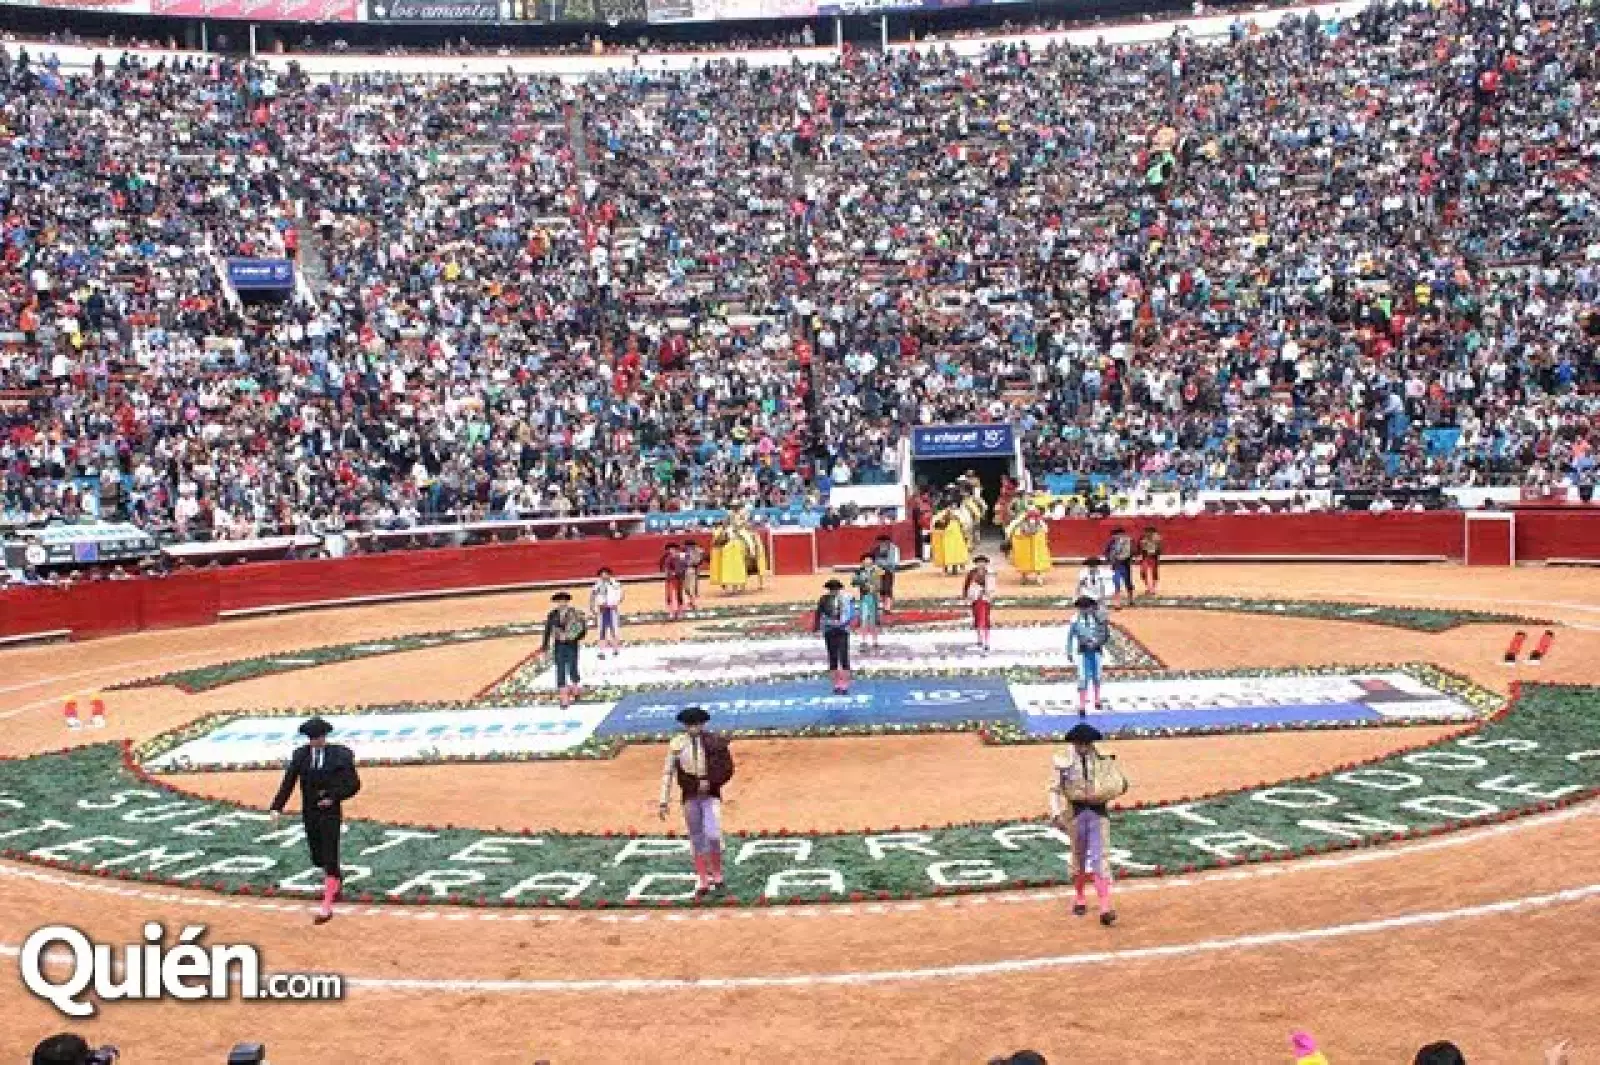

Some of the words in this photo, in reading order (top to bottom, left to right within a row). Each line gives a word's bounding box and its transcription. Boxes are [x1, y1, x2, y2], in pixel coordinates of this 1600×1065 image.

[613, 823, 1072, 866] PARA
[1137, 735, 1539, 827] TODOS
[0, 819, 846, 901] TEMPORADA
